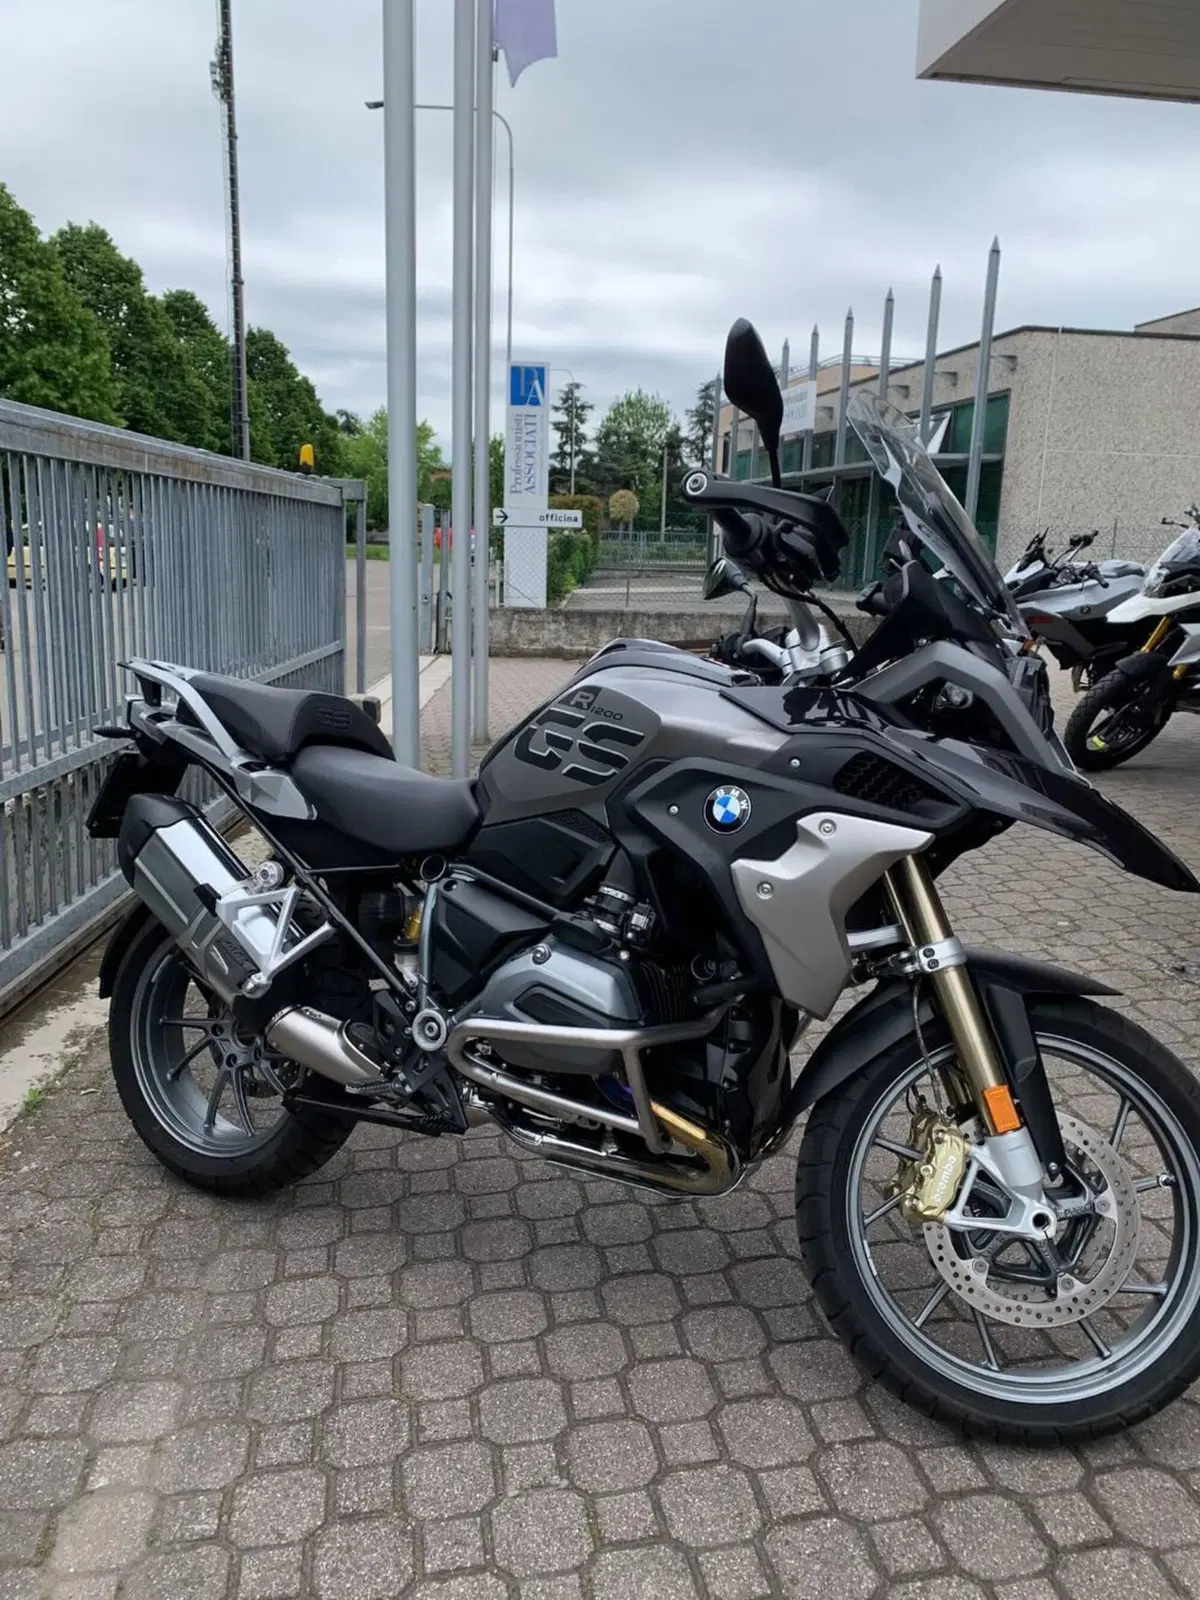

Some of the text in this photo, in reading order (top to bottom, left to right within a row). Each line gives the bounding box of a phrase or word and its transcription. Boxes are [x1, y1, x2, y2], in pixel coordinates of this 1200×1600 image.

[524, 414, 537, 496] ASSOCIATI
[539, 513, 578, 522] officina
[570, 691, 623, 721] R 1200
[514, 707, 645, 786] GS
[934, 1155, 956, 1204] brembo
